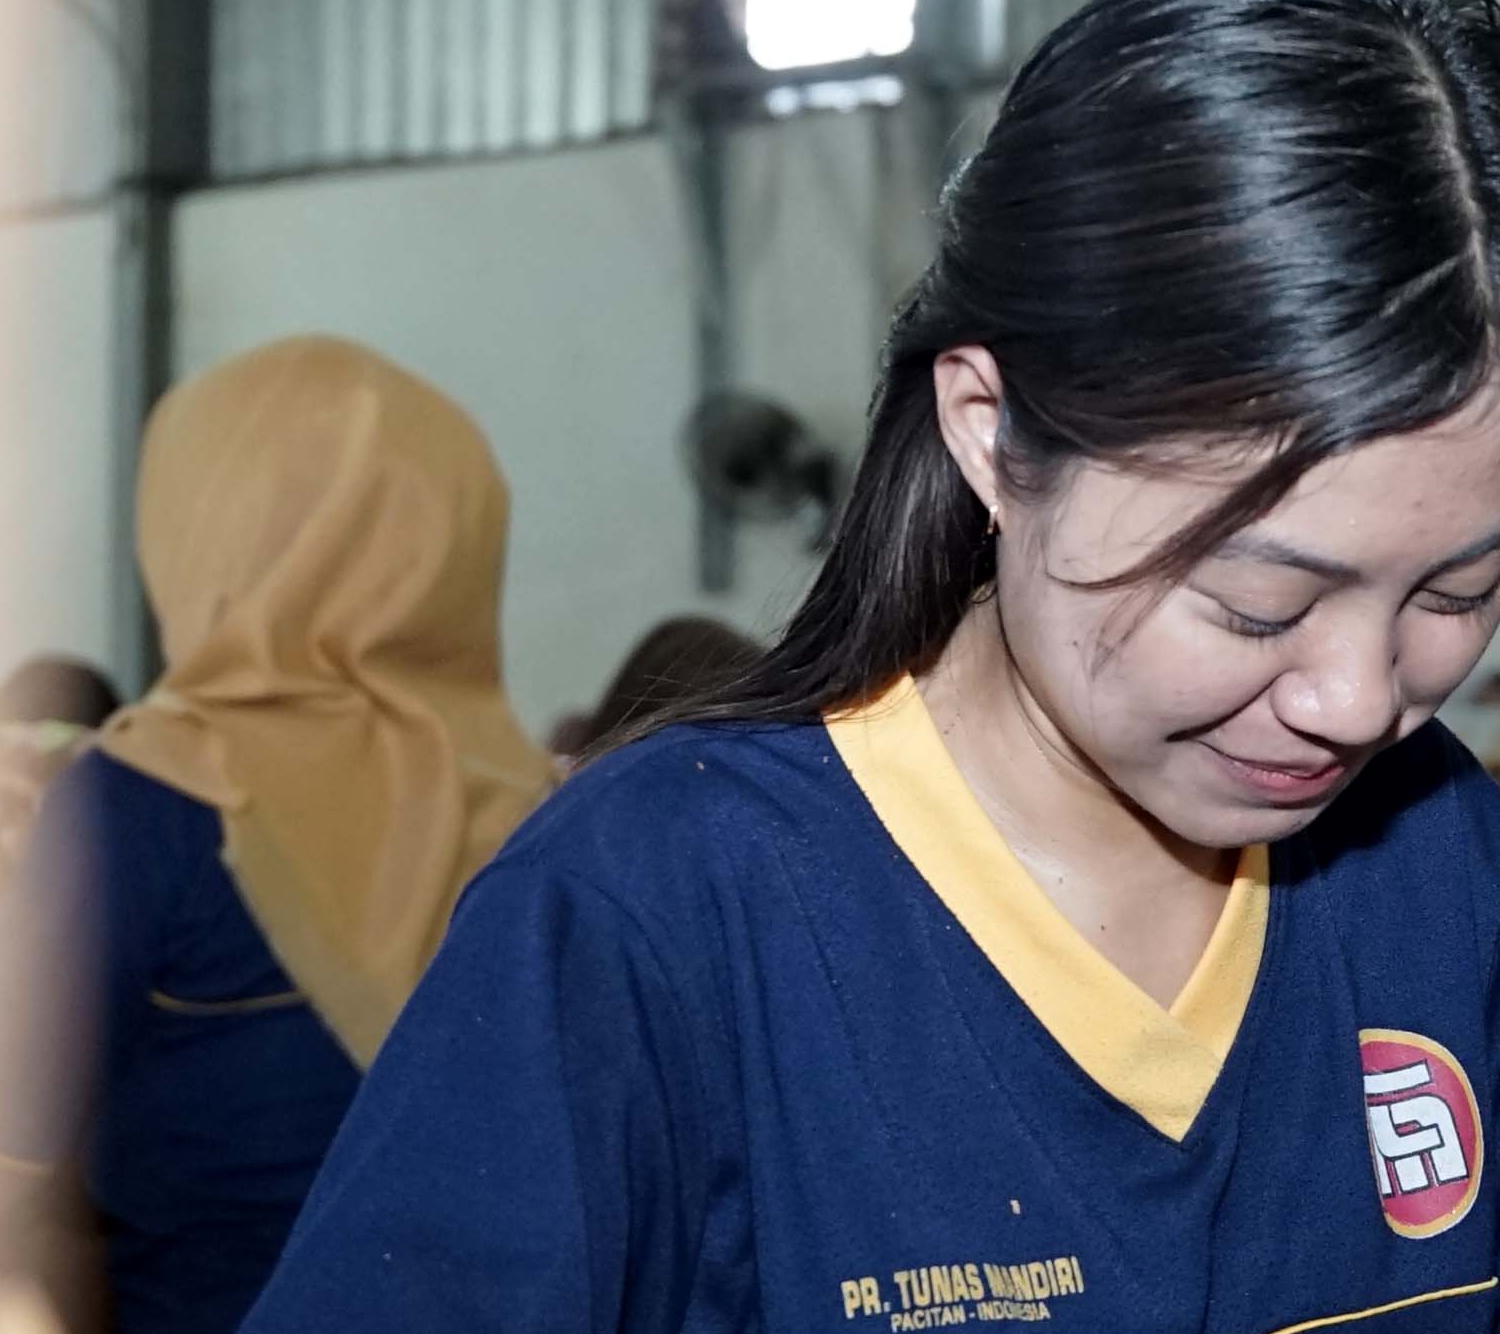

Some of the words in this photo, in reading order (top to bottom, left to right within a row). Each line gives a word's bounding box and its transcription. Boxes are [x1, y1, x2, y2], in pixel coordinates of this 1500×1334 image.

[840, 1276, 891, 1319] PR.
[893, 1263, 984, 1309] TUNAS
[891, 1304, 966, 1333] PACITAN
